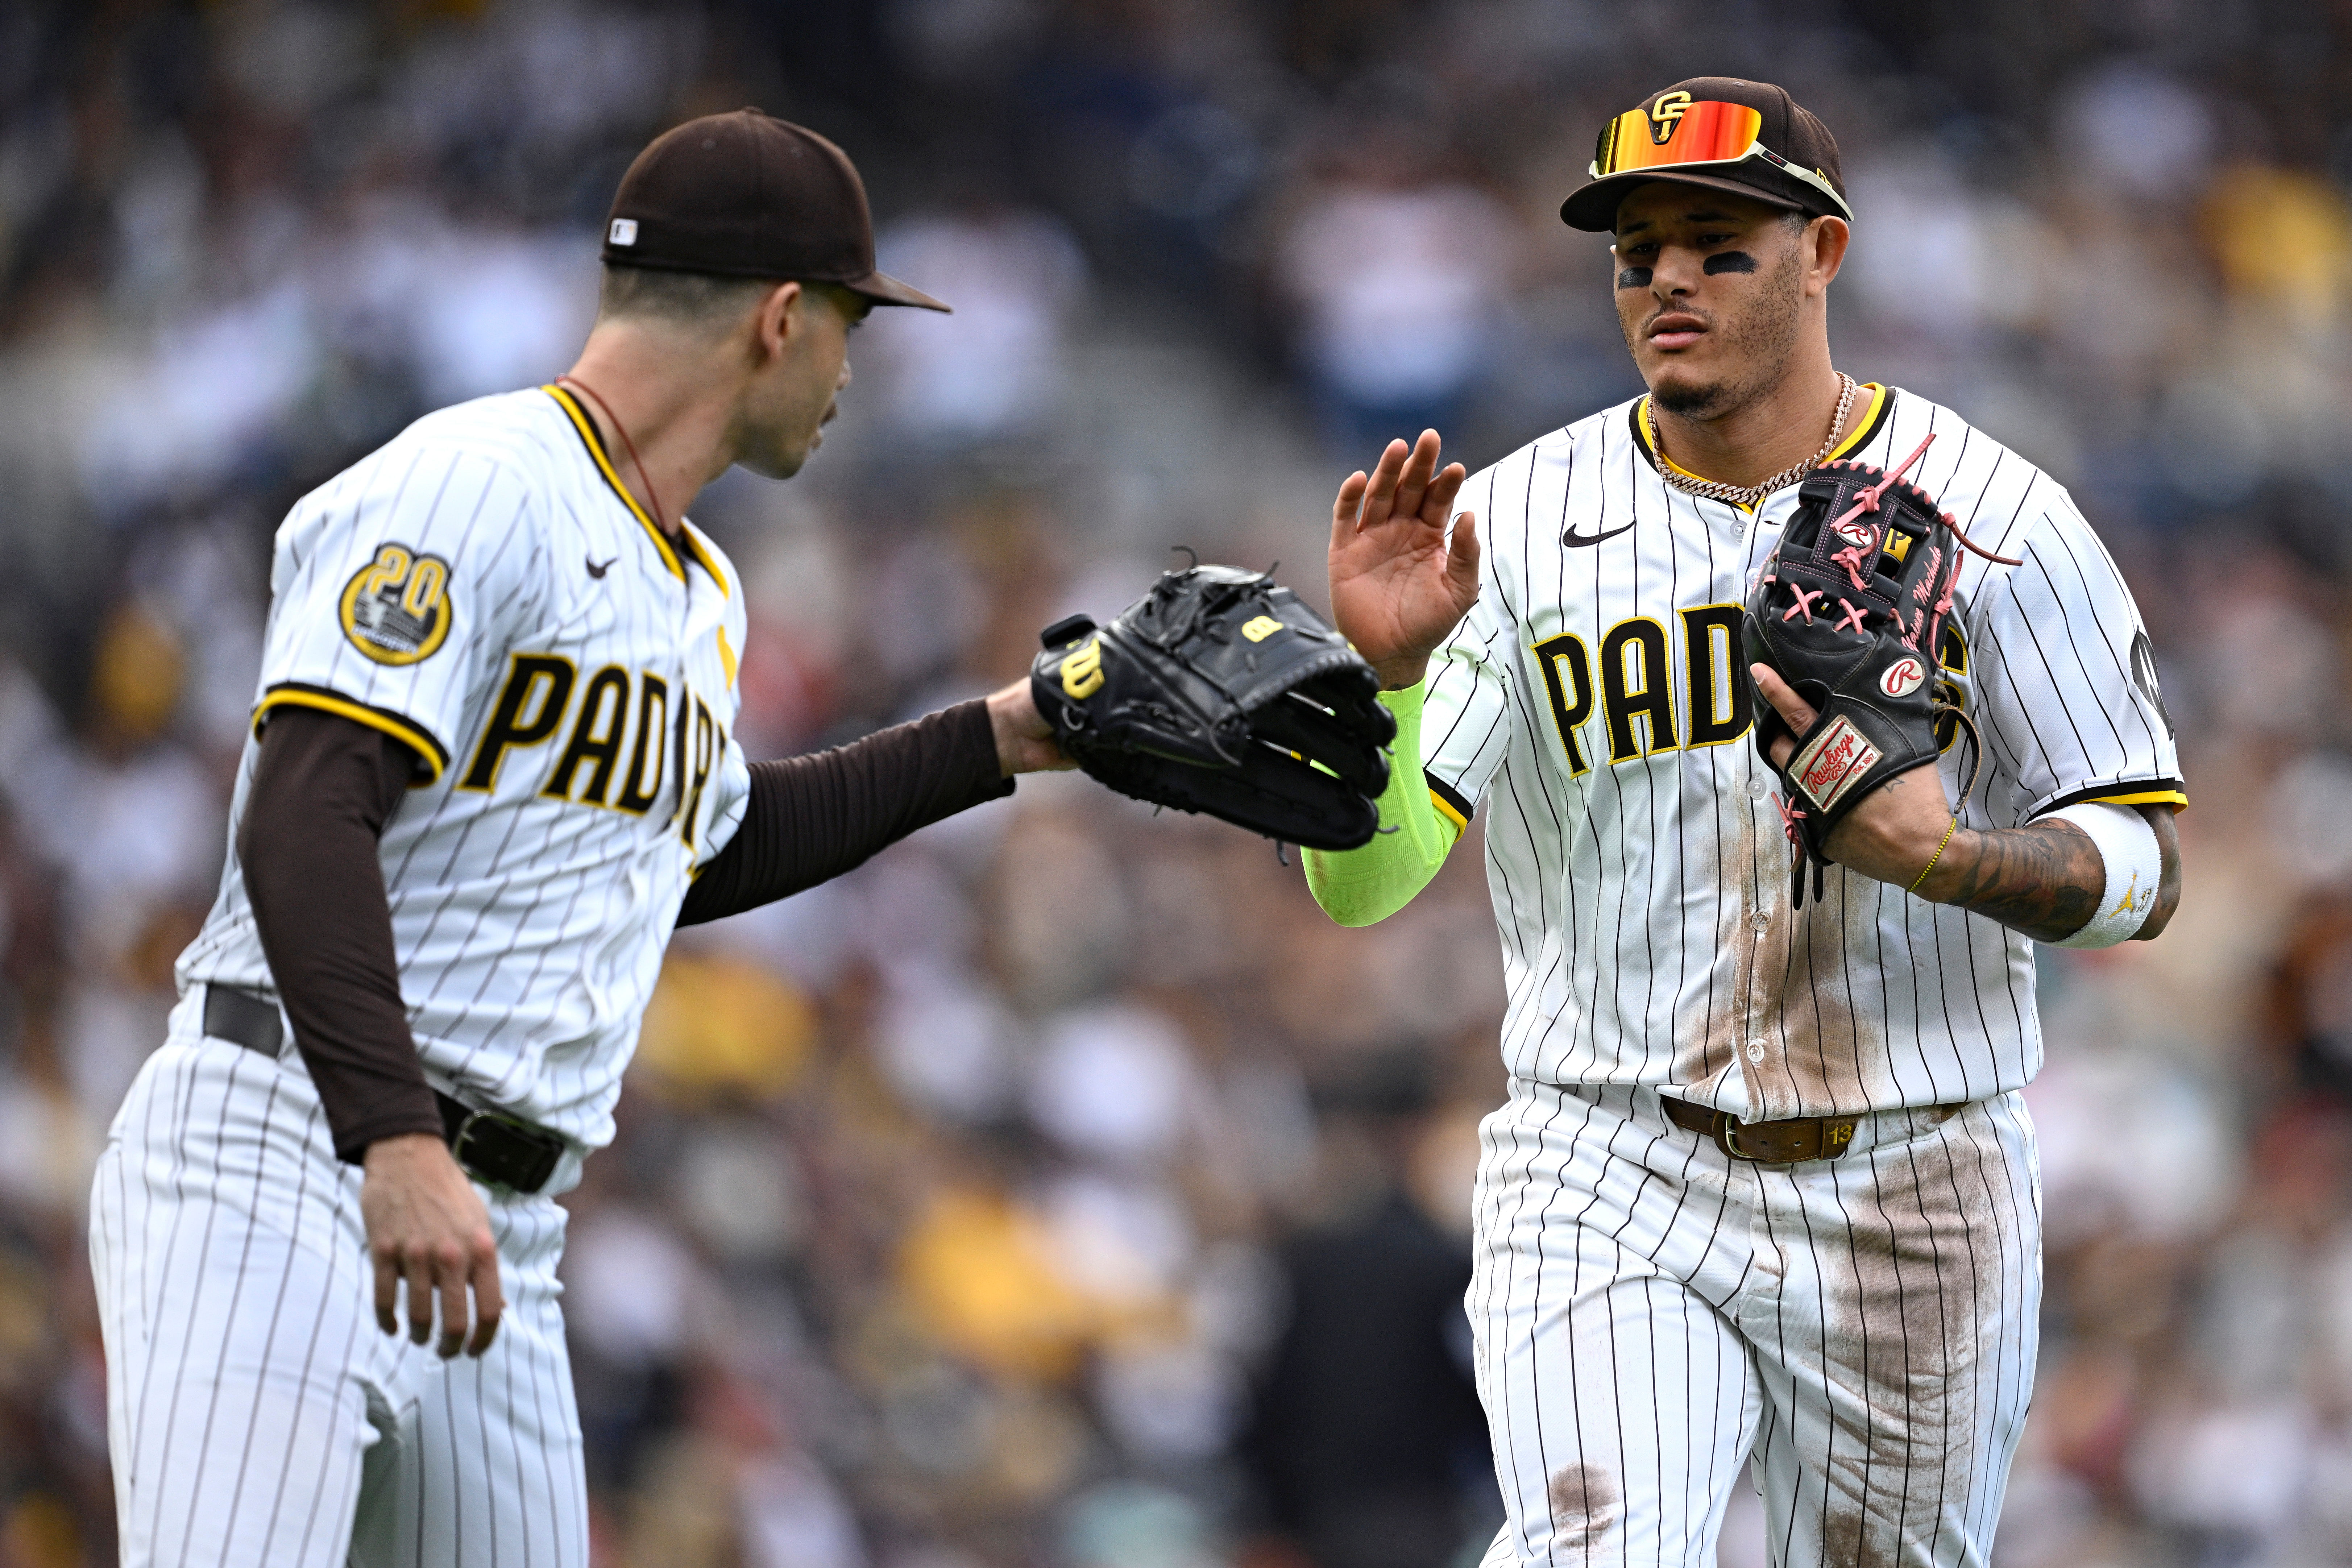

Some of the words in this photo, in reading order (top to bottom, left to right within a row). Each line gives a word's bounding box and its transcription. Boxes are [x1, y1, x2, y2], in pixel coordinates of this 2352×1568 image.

[367, 547, 445, 620] 20
[1913, 546, 1941, 606] Machado
[1807, 734, 1854, 794] Rawlings
[1829, 1125, 1851, 1144] 13
